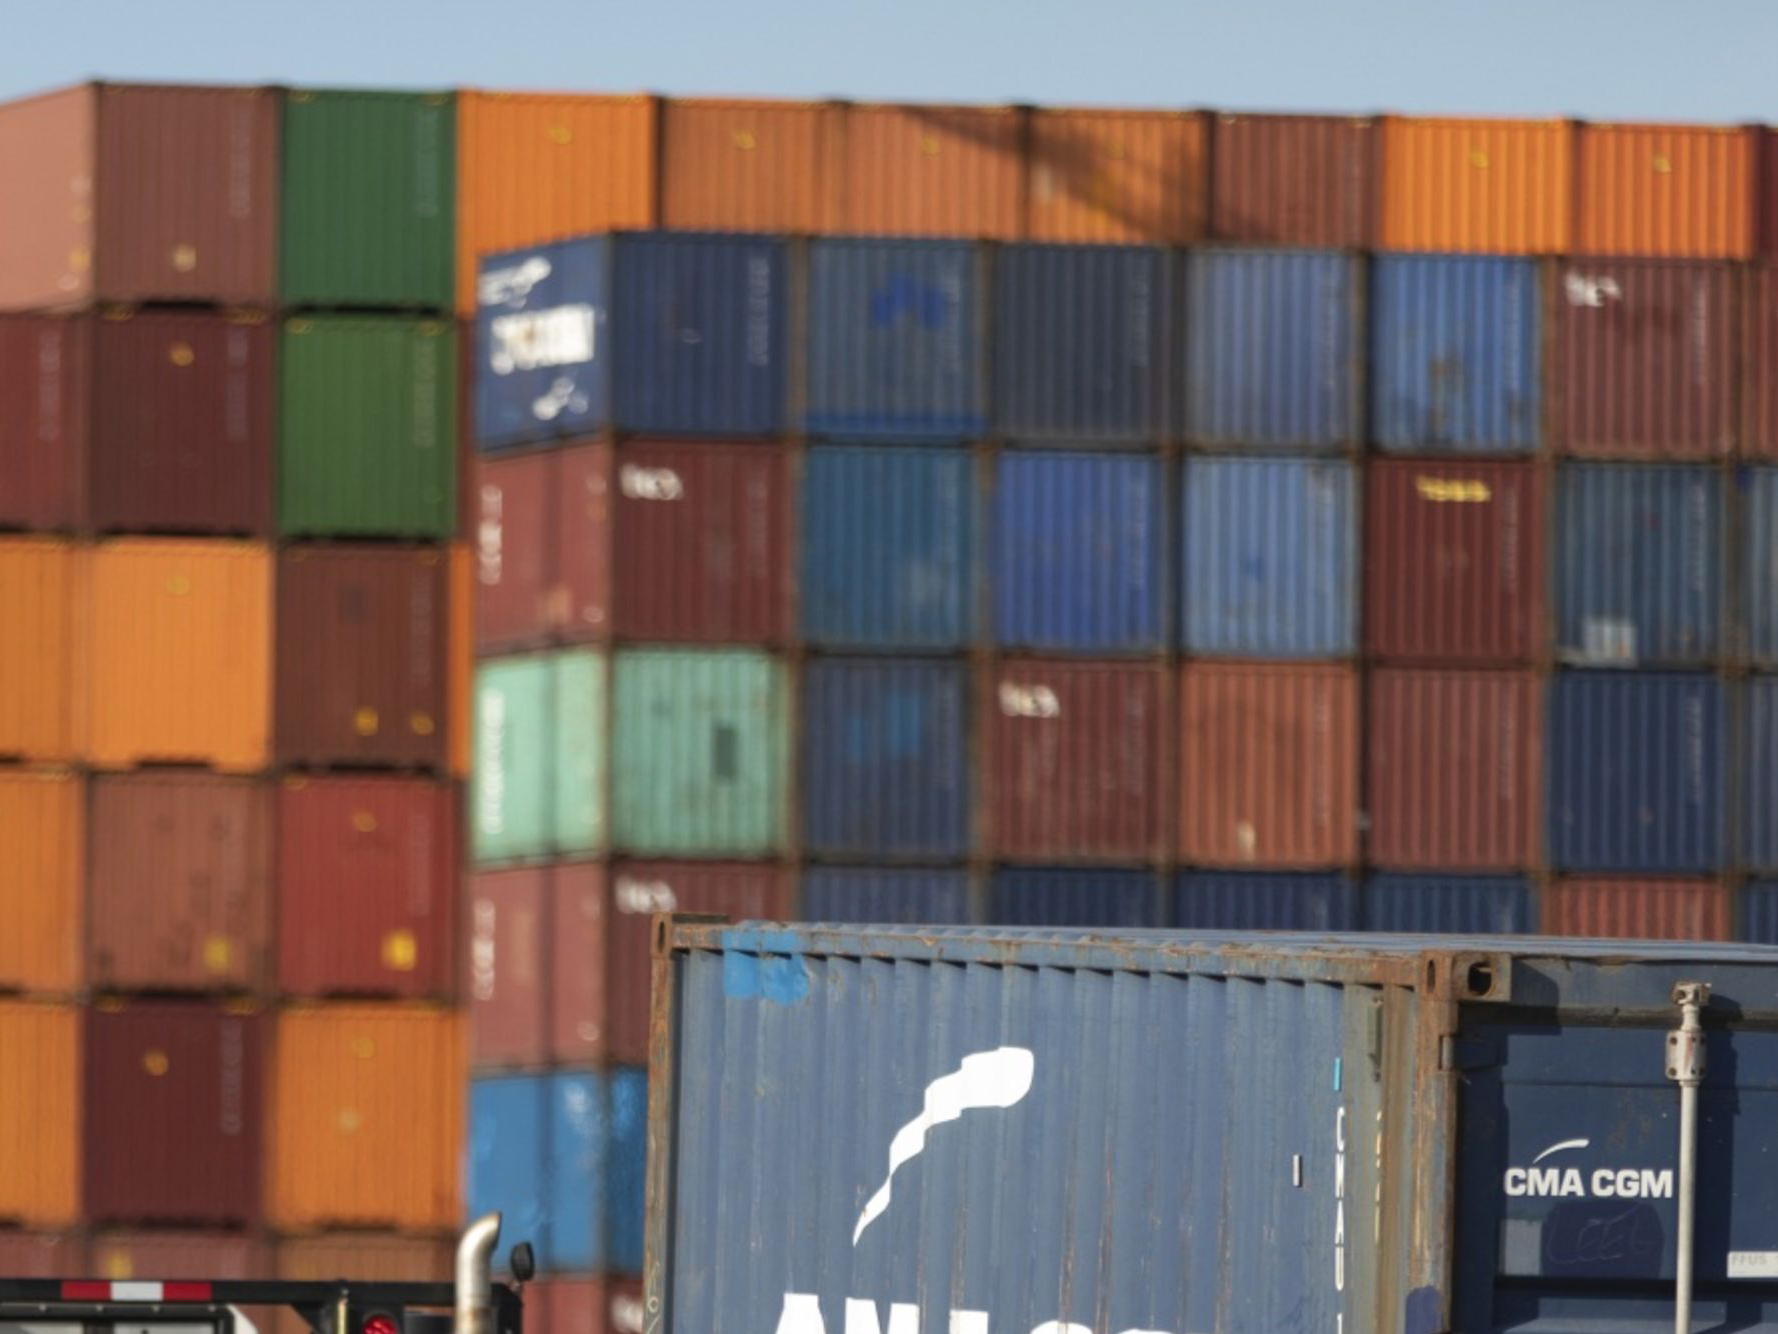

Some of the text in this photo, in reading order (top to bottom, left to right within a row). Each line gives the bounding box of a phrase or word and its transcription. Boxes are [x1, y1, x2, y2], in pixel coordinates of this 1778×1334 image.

[1334, 1106, 1345, 1292] CMAU
[1504, 1167, 1673, 1198] CMA CGM
